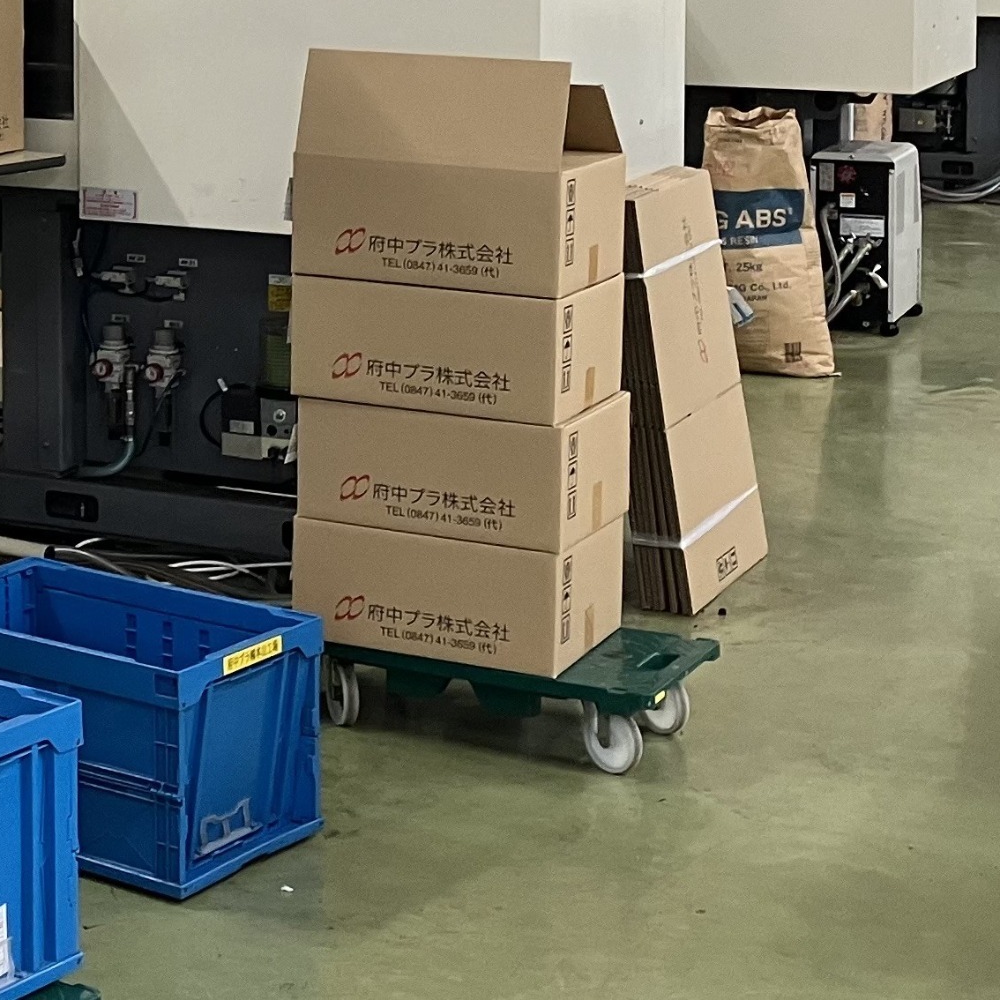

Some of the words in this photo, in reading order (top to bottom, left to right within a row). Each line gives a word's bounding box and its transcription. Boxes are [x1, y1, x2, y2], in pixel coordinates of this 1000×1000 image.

[735, 208, 787, 229] ABS
[368, 235, 513, 265] 府中プラ株式会社
[366, 359, 511, 392] 府中プラ株式会社
[372, 483, 516, 518] 府中プラ株式会社
[368, 604, 511, 642] 府中プラ株式会社
